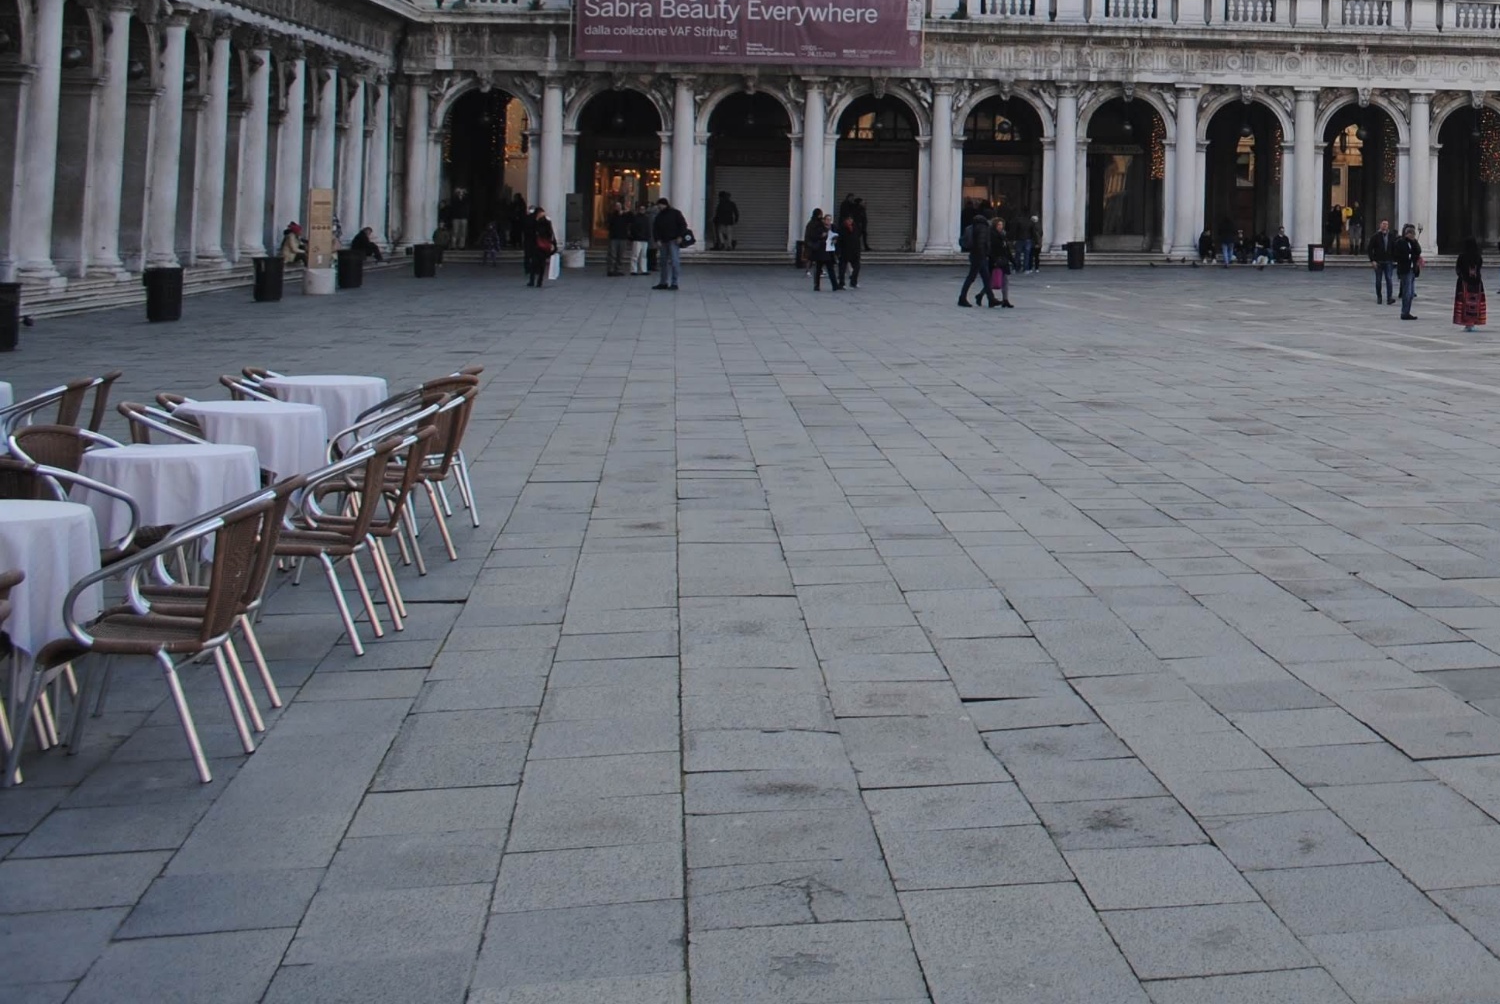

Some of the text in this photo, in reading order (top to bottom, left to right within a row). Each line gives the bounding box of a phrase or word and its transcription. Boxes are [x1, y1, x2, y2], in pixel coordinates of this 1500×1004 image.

[747, 0, 878, 26] Everywhere
[584, 26, 738, 40] dalla collezione VAF Stiftung
